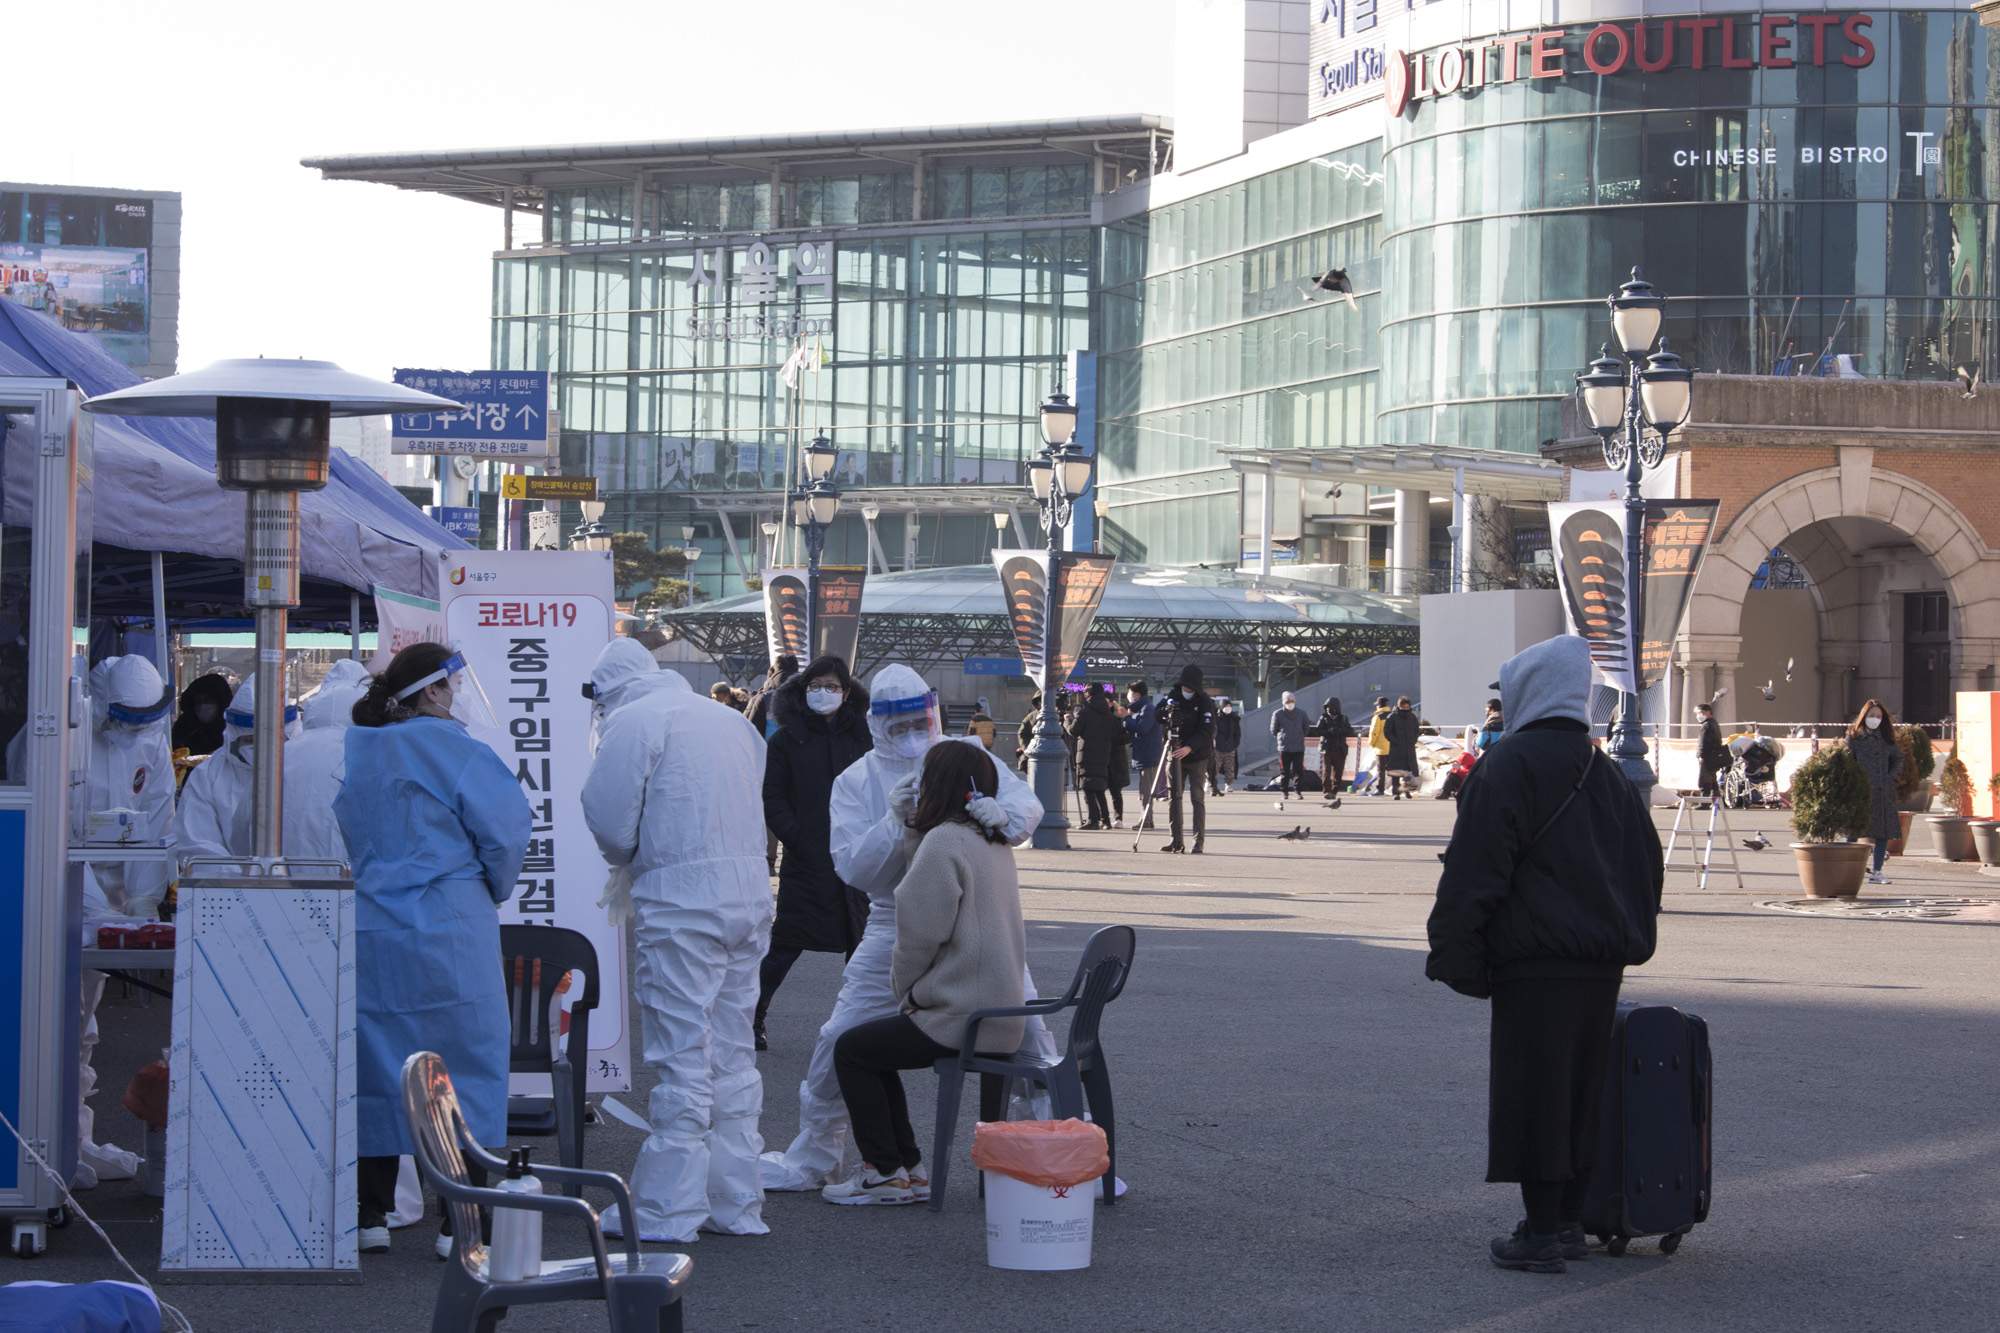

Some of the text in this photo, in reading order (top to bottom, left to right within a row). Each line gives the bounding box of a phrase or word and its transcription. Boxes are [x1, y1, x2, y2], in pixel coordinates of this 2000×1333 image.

[1413, 14, 1876, 101] LOTTE OUTLETS
[1319, 50, 1358, 97] Seoul
[1673, 147, 1777, 166] CHINESE
[1801, 147, 1888, 164] BISTRO
[686, 241, 833, 304] 서울역
[686, 312, 833, 341] Seoul Station
[499, 378, 540, 390] 롯데마트
[435, 402, 510, 431] 주차장
[408, 440, 529, 454] 우측차로 주차장 전용 진입로
[469, 572, 497, 582] 서울중구
[477, 602, 577, 628] 코로나19
[238, 1017, 253, 1037] STEEL
[306, 1018, 322, 1037] STEEL
[250, 1037, 273, 1071] STAINLESS
[314, 1151, 329, 1170] STEEL
[244, 1151, 280, 1204] STAINLESS STEEL
